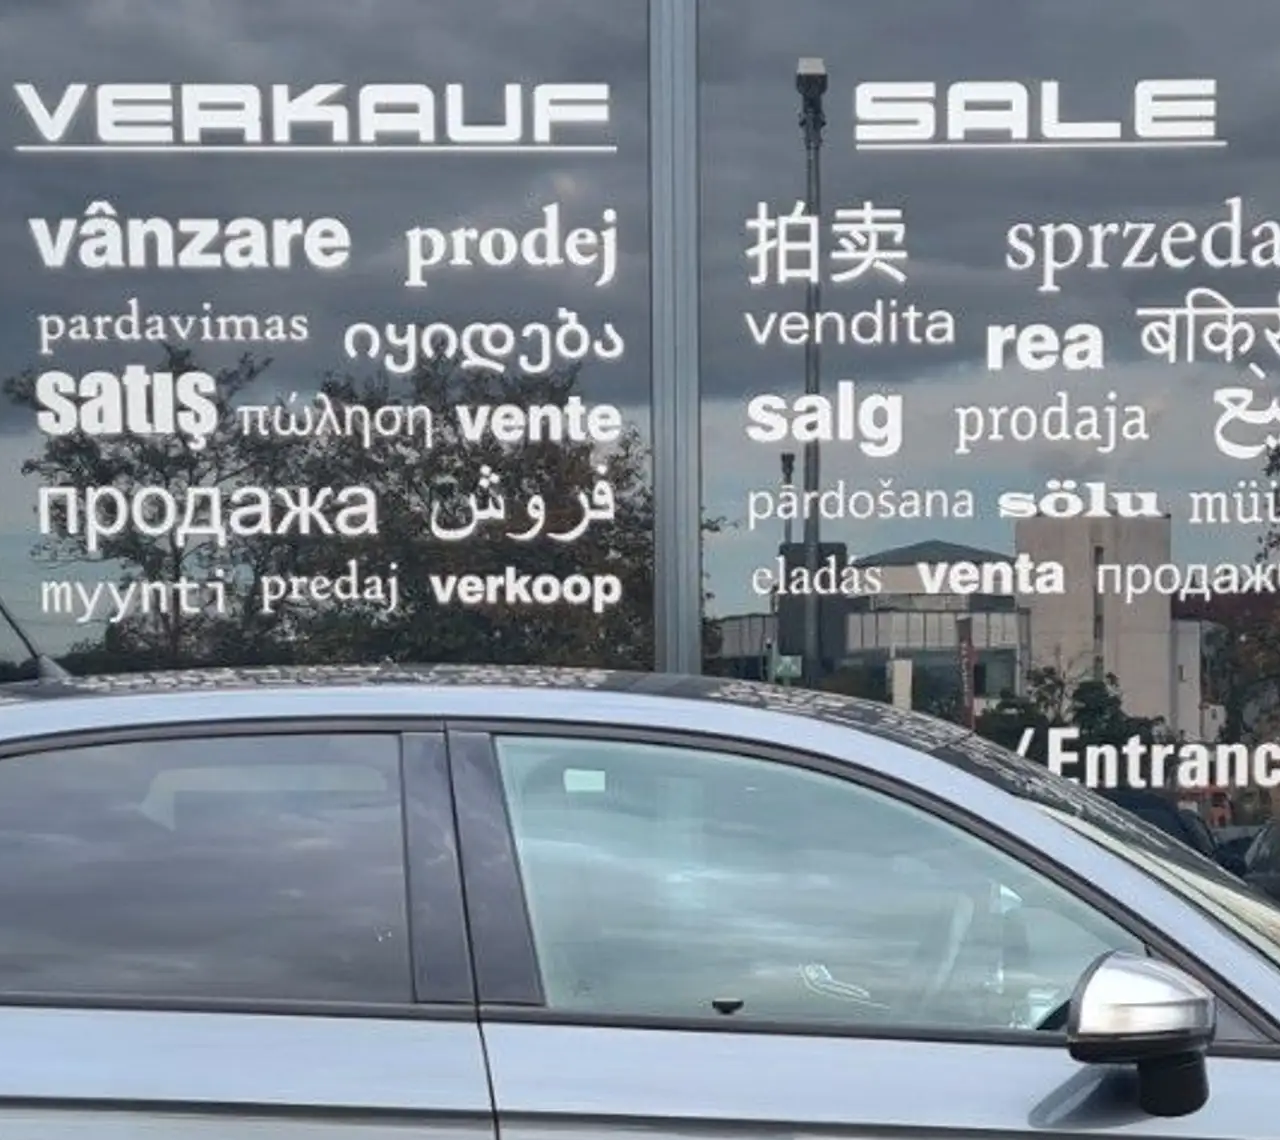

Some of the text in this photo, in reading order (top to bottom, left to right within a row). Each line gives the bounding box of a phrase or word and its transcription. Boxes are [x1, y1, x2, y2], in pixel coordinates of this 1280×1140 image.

[14, 83, 610, 143] VERKAUF
[855, 80, 1218, 140] SALE
[30, 201, 616, 286] vânzare prodej
[746, 201, 907, 284] 拍卖
[40, 298, 307, 353] pardavimas
[345, 308, 623, 373] იყიდება
[746, 300, 1104, 371] vendita rea
[37, 365, 217, 450] satış
[237, 392, 432, 449] πώληση
[455, 397, 622, 443] vente
[745, 381, 1149, 458] salg prodaja
[38, 482, 378, 552] продажа
[749, 478, 973, 532] pārdošana
[998, 480, 1162, 518] sölu
[42, 560, 621, 622] myynti predaj verkoop
[752, 554, 1064, 596] eladás venta
